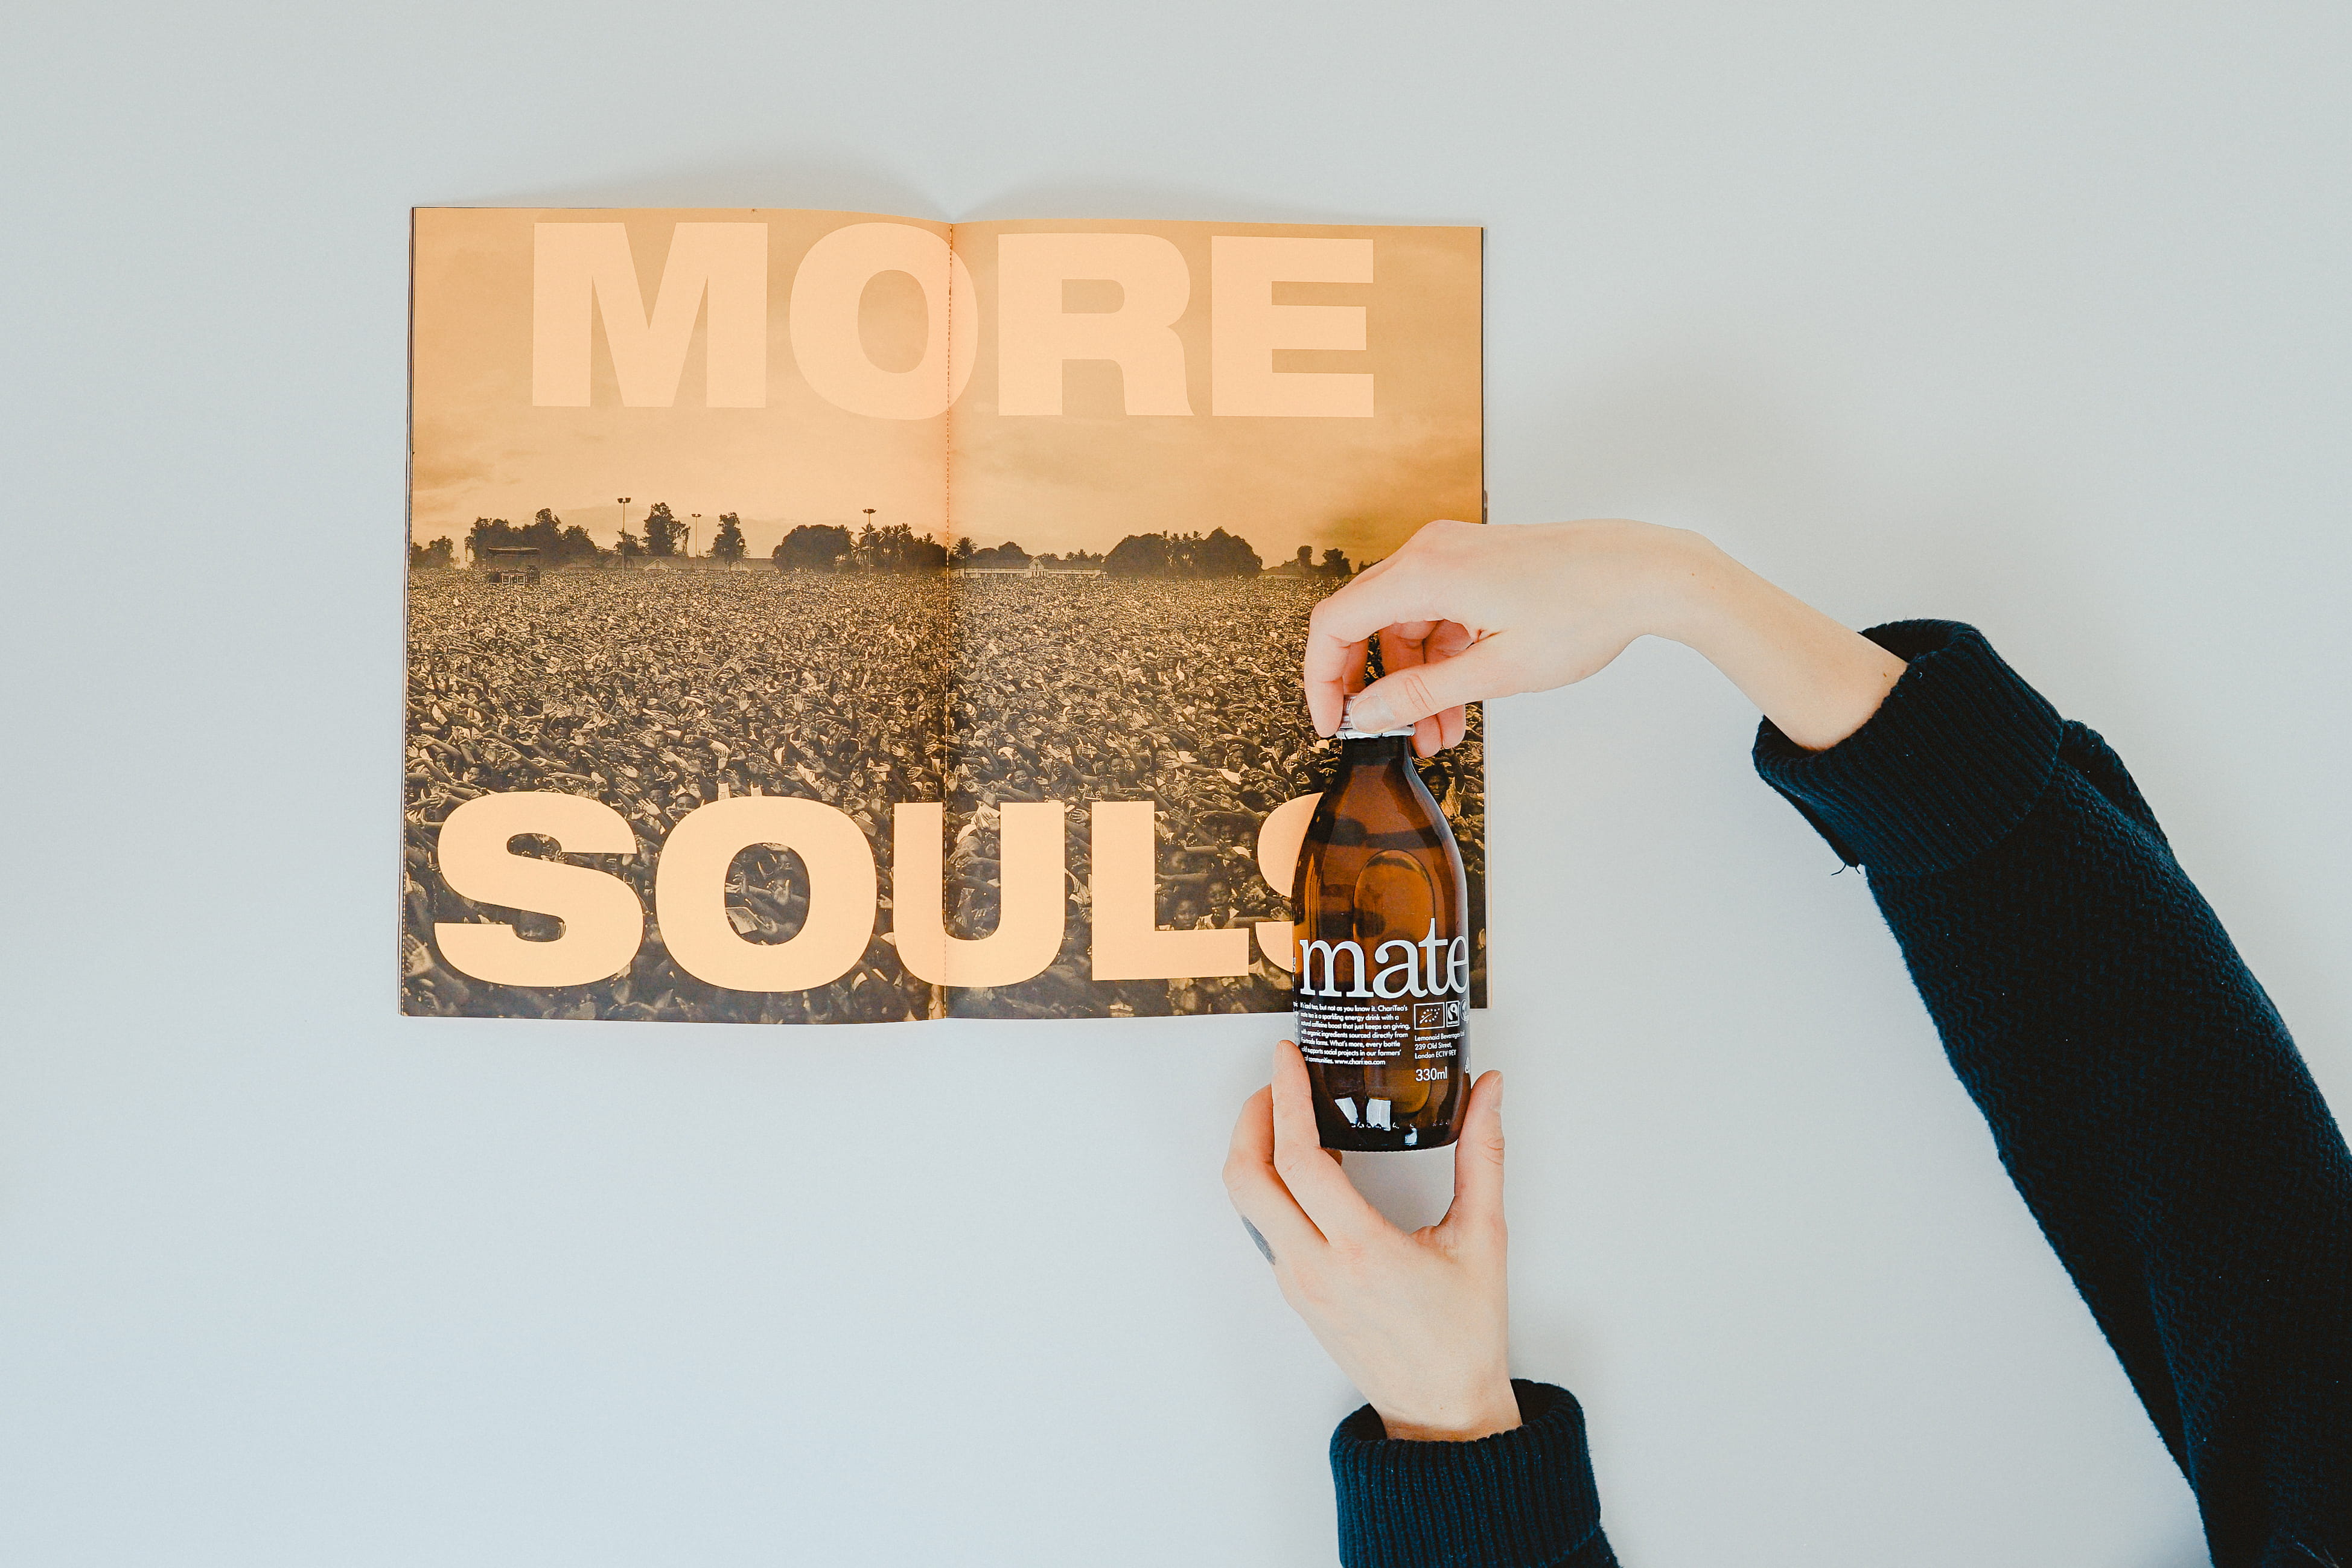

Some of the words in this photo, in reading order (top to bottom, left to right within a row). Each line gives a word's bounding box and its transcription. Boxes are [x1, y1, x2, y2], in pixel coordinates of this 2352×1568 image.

[534, 222, 1374, 419] MORE
[1299, 918, 1468, 999] mate
[1415, 1033, 1440, 1042] Lemonaid
[1415, 1066, 1447, 1082] 330ml
